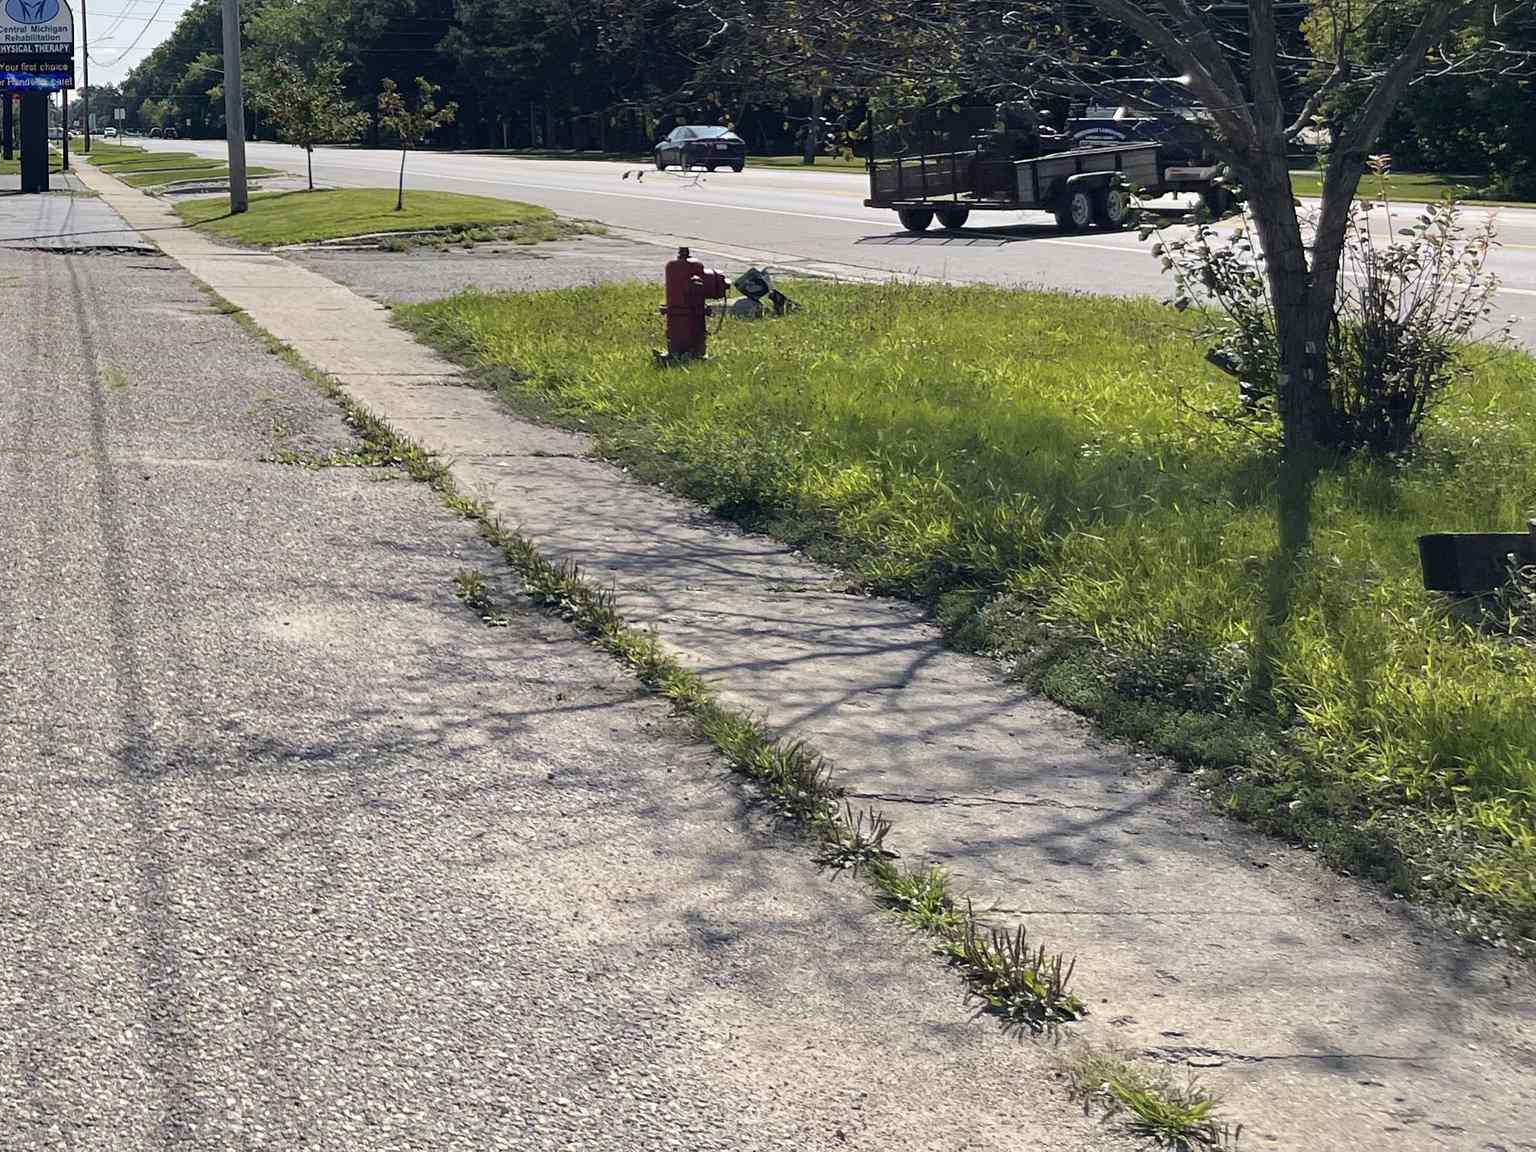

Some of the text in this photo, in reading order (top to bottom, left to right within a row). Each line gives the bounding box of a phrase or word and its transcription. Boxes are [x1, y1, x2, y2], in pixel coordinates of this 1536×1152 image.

[30, 25, 68, 35] Michigan
[4, 33, 61, 42] Rehabilitation
[34, 43, 70, 54] THERAPY
[0, 62, 19, 71] Your
